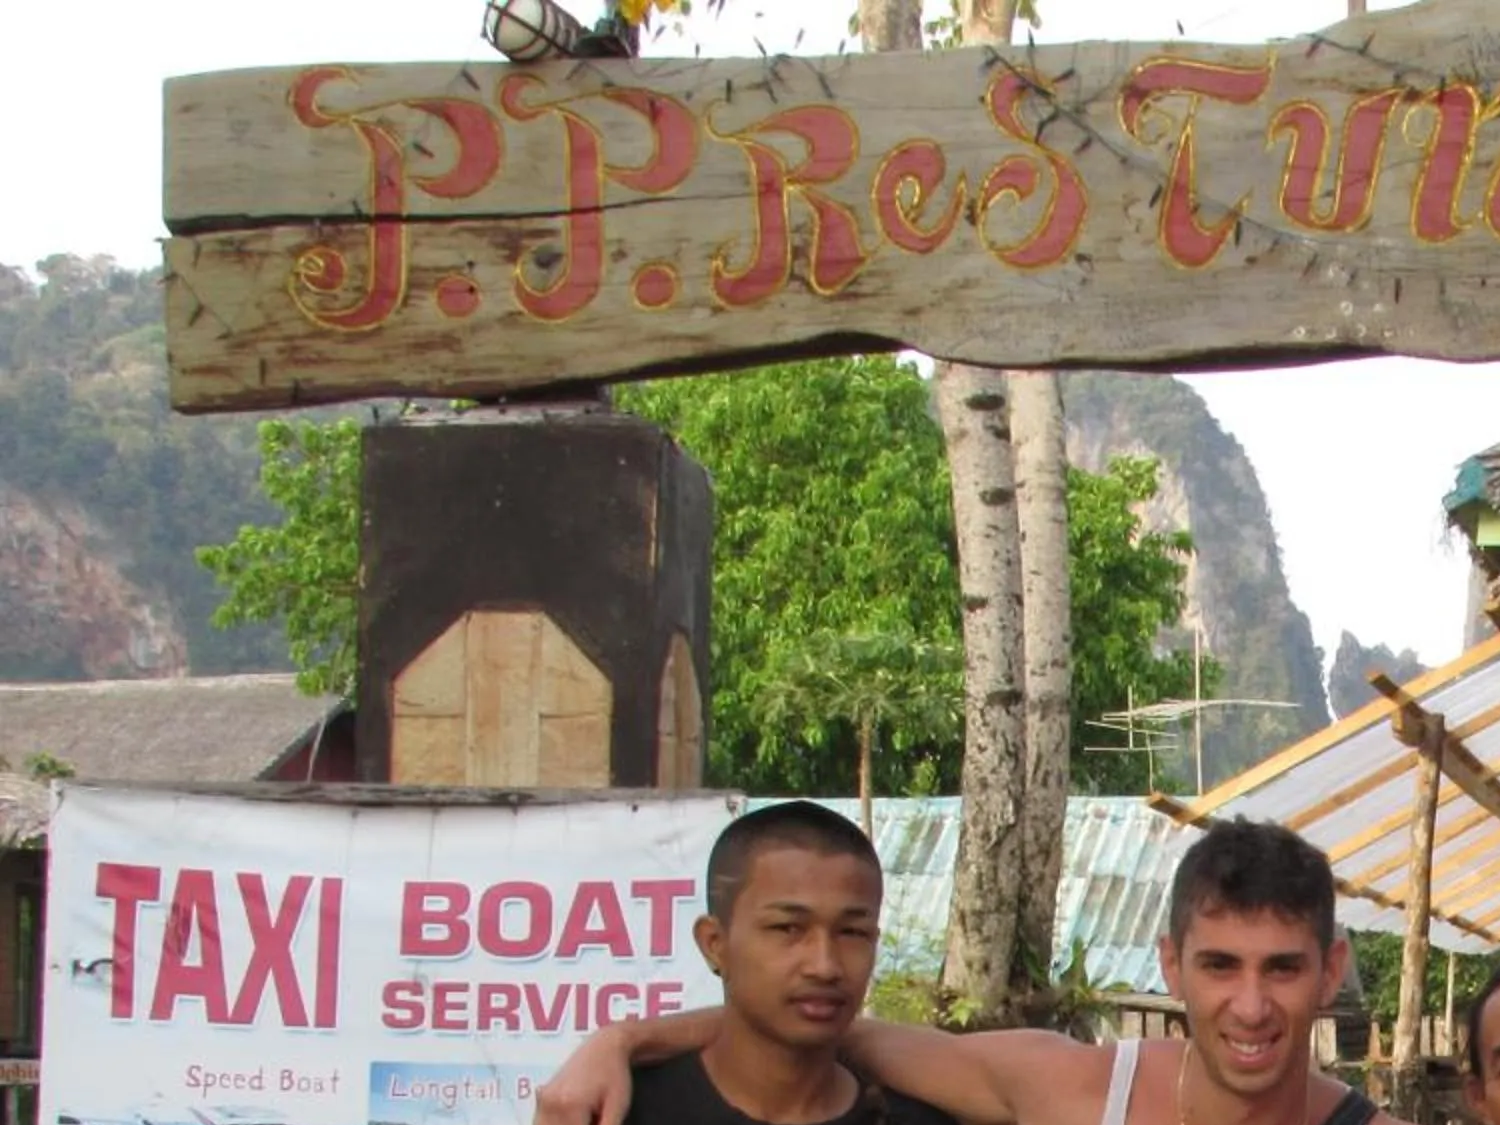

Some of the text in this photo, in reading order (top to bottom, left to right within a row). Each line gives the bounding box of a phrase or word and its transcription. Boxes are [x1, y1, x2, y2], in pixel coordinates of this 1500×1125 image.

[96, 862, 696, 1029] TAXI BOAT
[381, 981, 684, 1032] SERVICE
[186, 1064, 341, 1095] Speed Boat
